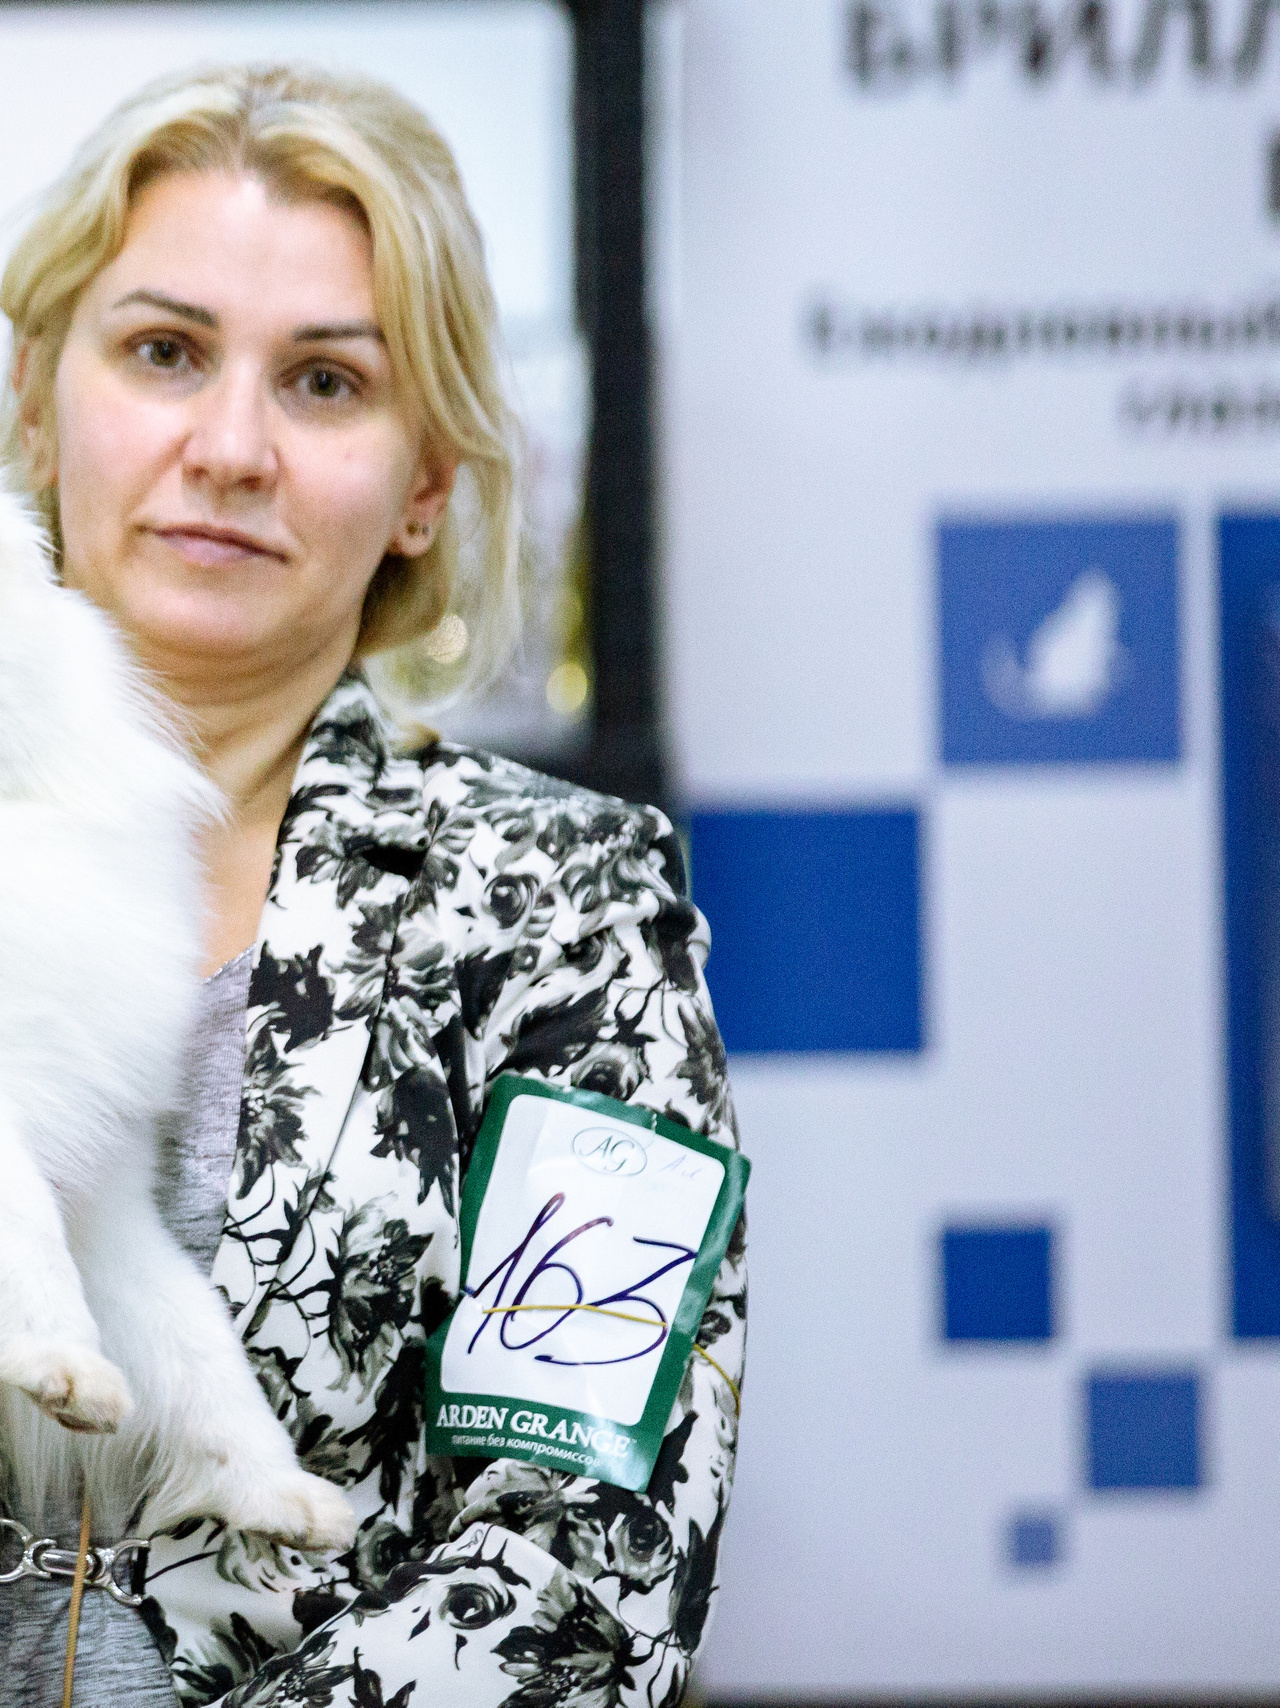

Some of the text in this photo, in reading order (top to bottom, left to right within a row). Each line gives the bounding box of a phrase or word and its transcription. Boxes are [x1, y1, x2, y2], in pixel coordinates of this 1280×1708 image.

[463, 1191, 698, 1367] 163
[435, 1403, 632, 1458] ARDEN GRANGE
[486, 1432, 506, 1447] без
[506, 1437, 601, 1467] компромиссов
